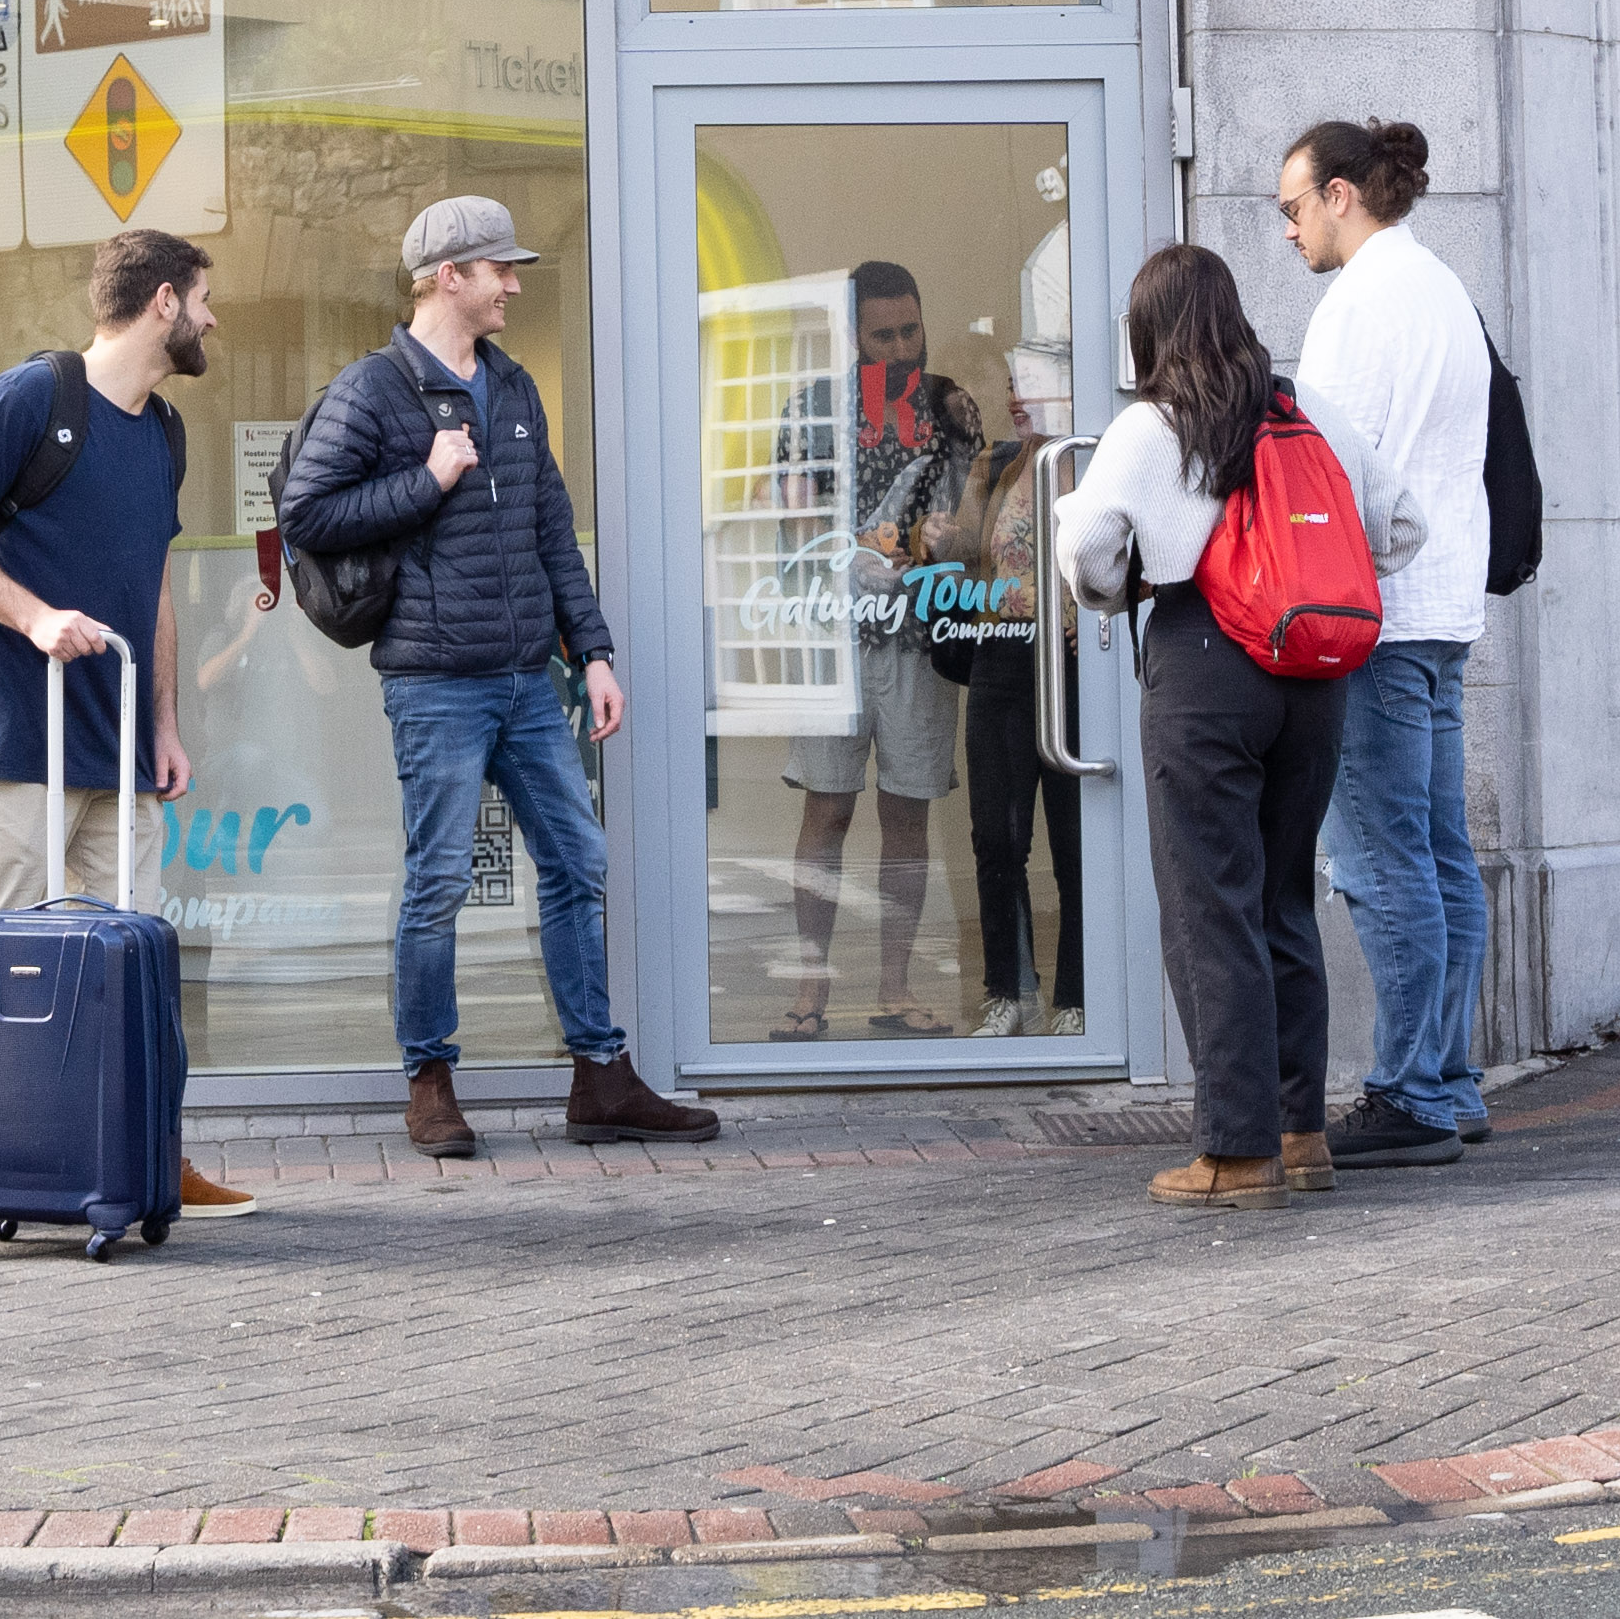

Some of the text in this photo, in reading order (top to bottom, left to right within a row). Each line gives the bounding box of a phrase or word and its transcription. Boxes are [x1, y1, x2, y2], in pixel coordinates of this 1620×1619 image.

[243, 449, 267, 457] Hostel
[738, 561, 1023, 635] Galway Tour
[932, 616, 1037, 646] Company
